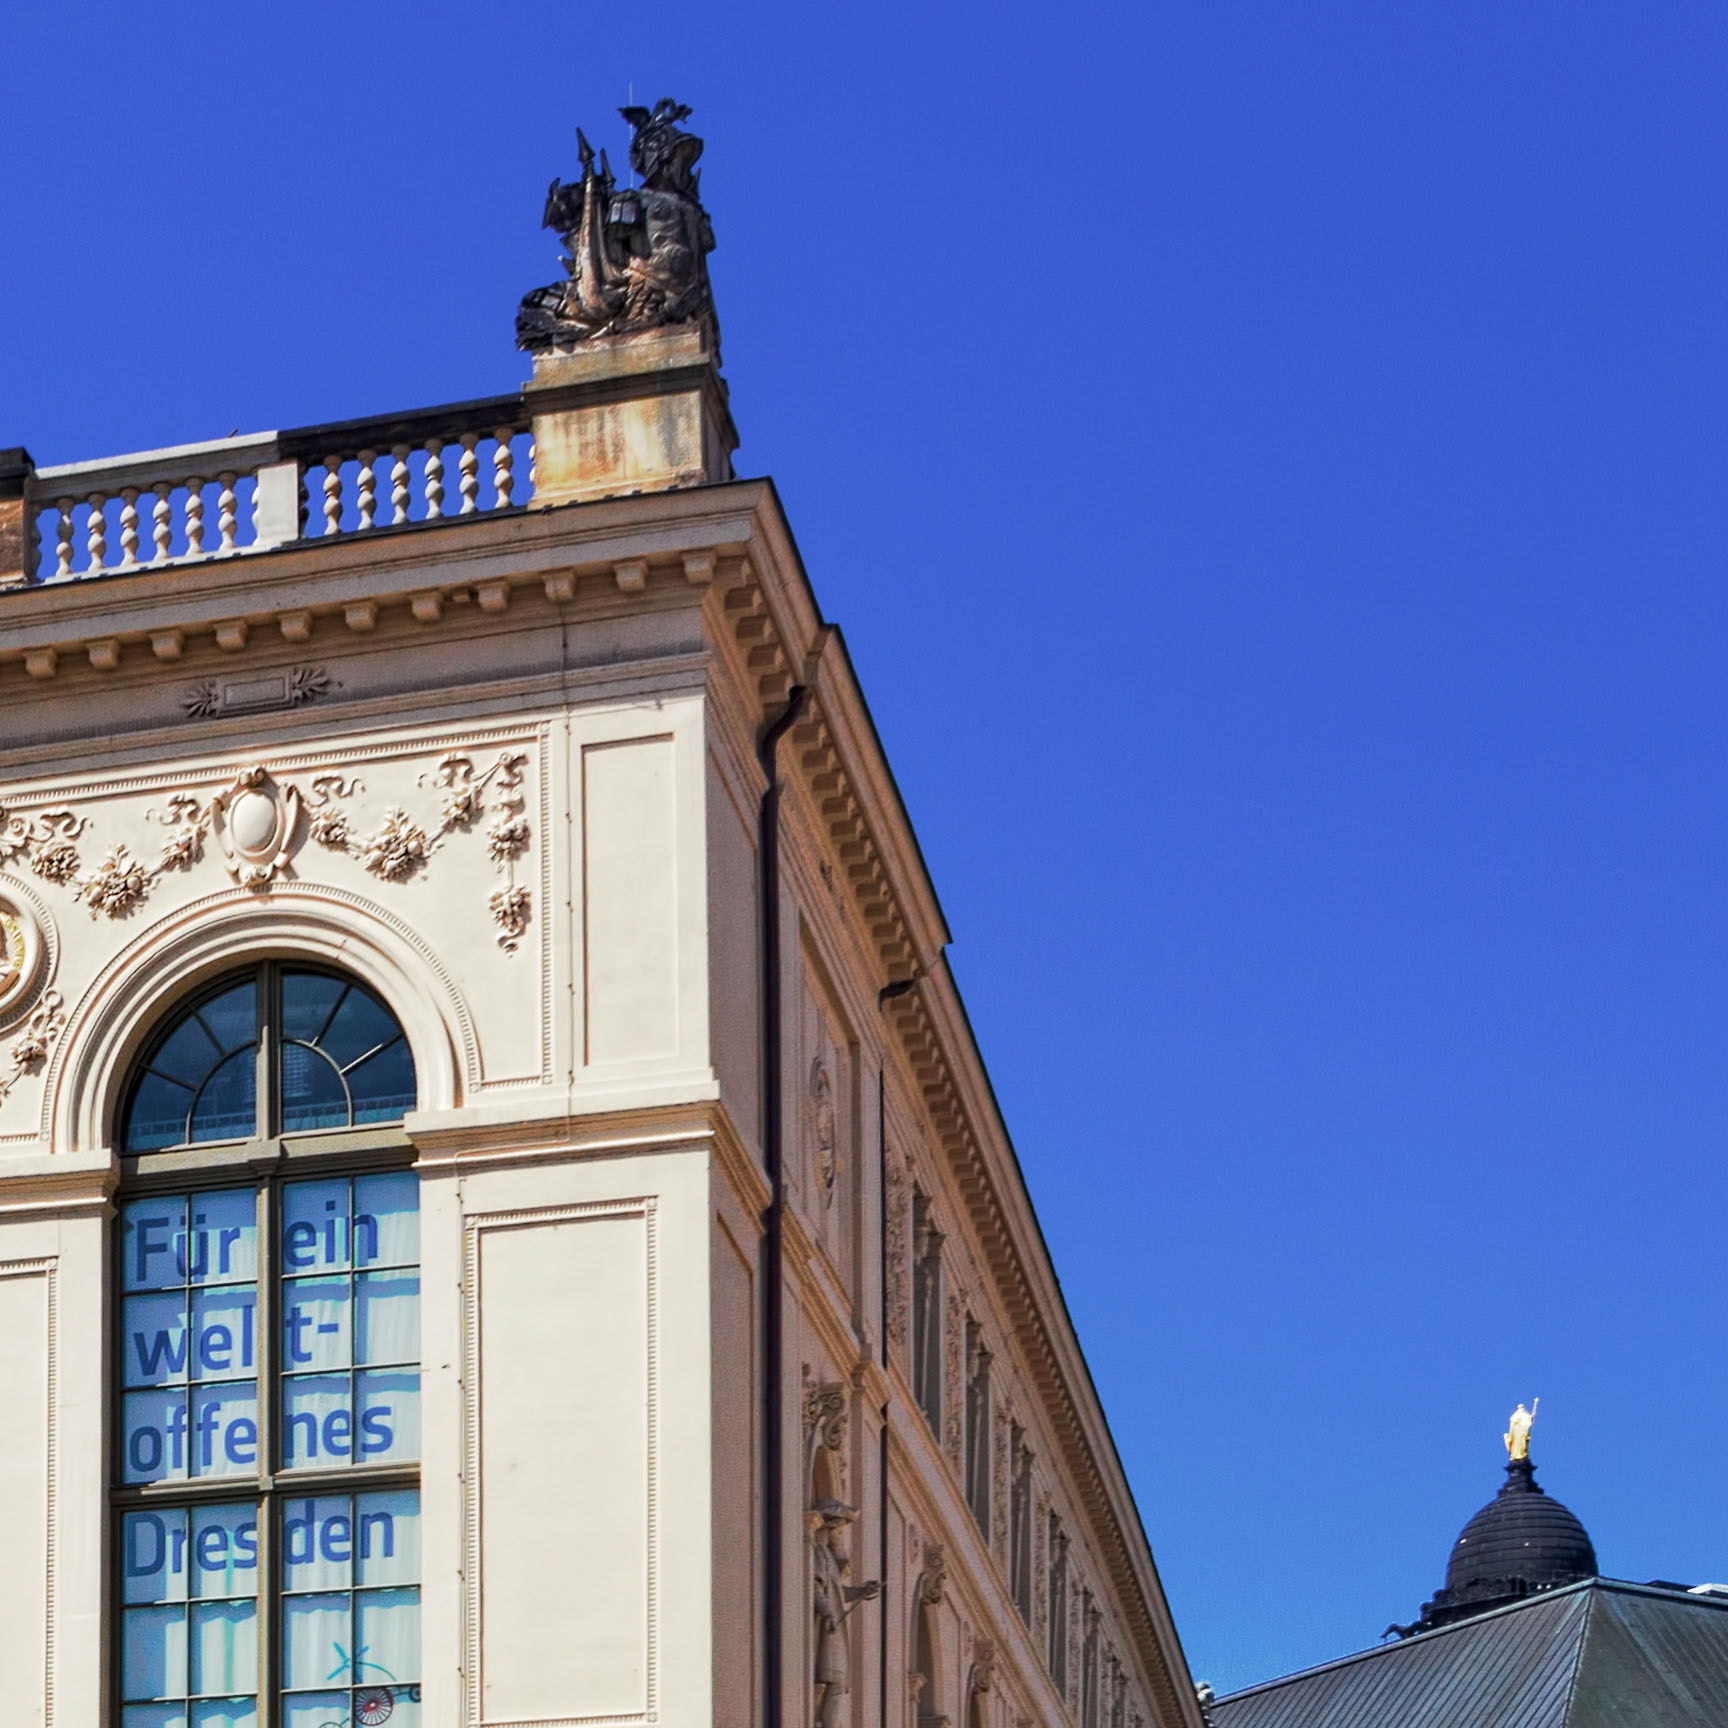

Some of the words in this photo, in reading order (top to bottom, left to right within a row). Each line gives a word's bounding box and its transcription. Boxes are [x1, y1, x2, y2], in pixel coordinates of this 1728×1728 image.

[136, 1213, 240, 1282] Für
[284, 1201, 378, 1267] ein
[133, 1304, 339, 1377] welt-
[129, 1402, 393, 1473] offenes
[126, 1499, 394, 1577] Dresden
